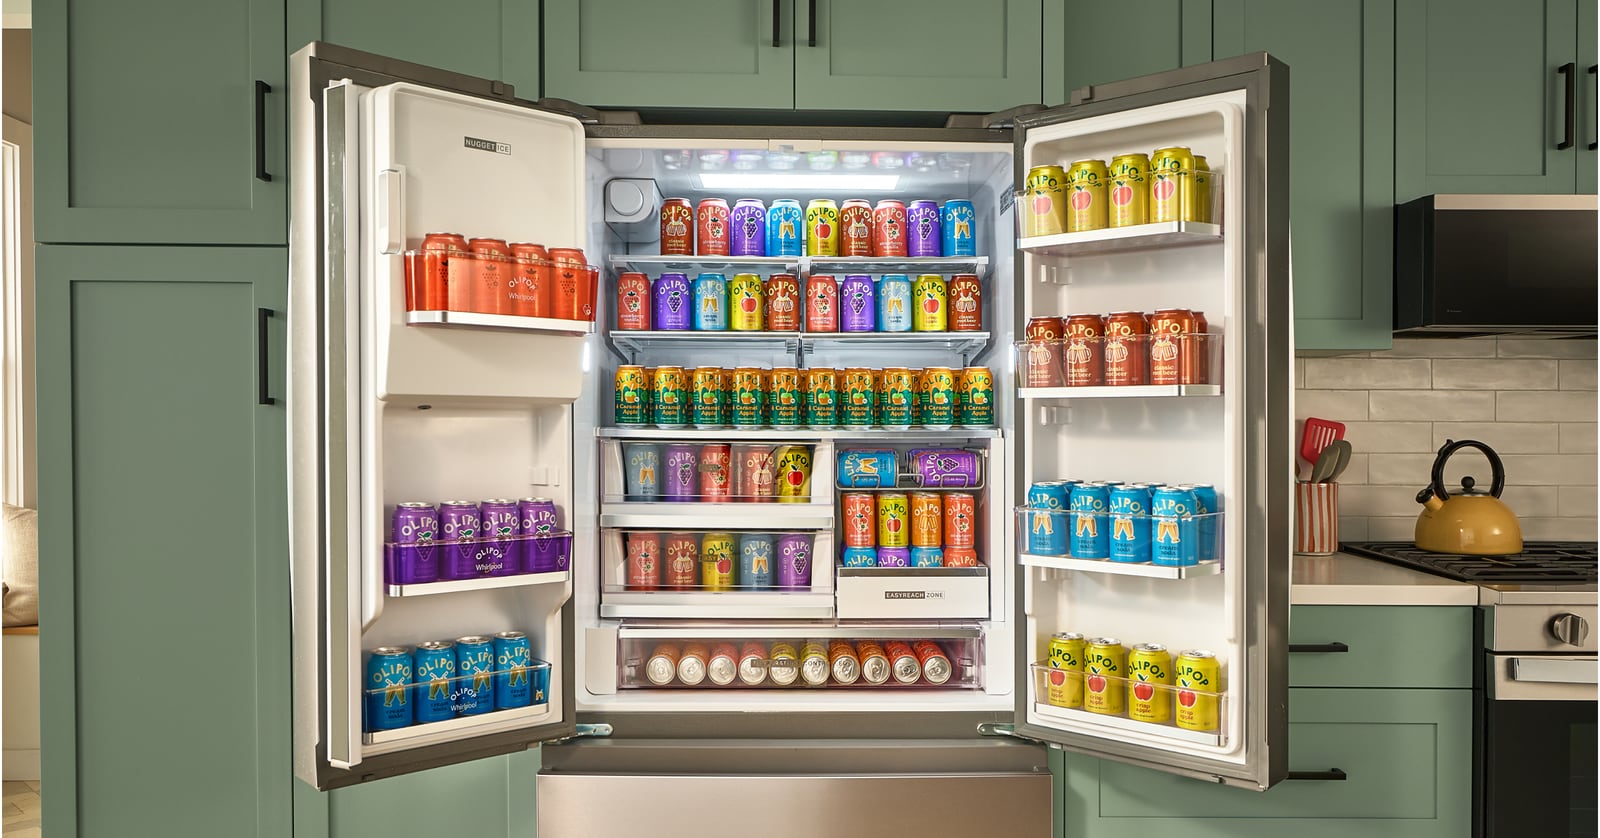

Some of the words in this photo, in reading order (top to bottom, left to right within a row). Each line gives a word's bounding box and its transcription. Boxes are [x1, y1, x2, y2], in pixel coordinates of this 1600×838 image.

[465, 138, 495, 151] NUGGET
[497, 145, 509, 153] ICE
[508, 276, 536, 290] OLIPOP
[475, 547, 503, 560] OLIPOP
[450, 688, 477, 701] OLIPOP
